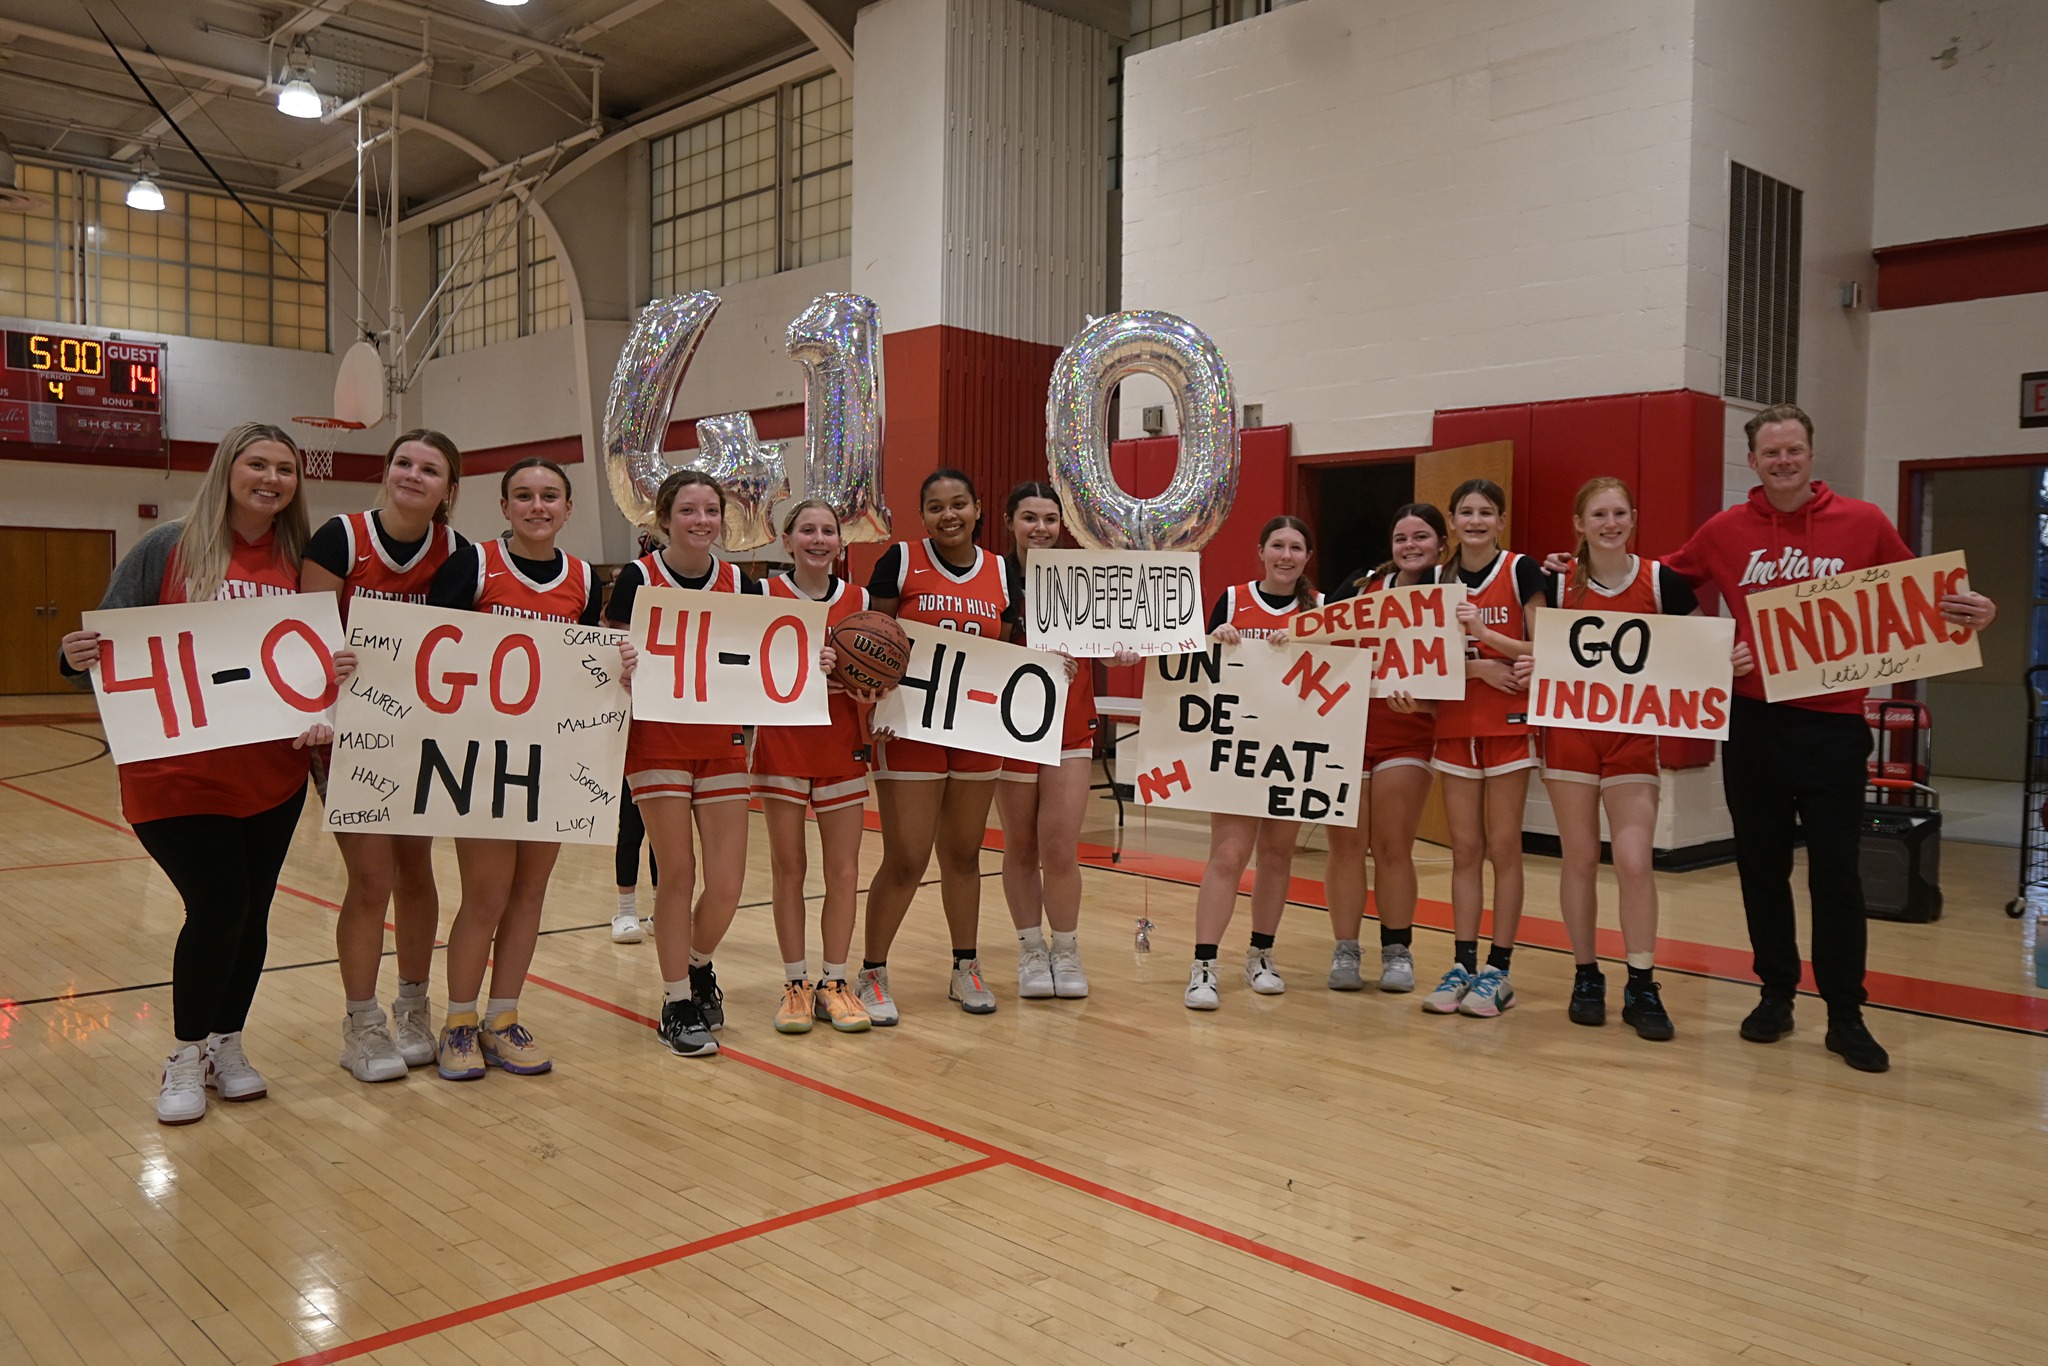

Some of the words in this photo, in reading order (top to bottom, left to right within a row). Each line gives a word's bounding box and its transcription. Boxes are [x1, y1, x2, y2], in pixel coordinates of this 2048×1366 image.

[29, 335, 101, 375] 5:00
[107, 345, 157, 363] GUEST
[40, 373, 72, 382] PERIOD
[48, 381, 64, 400] 4
[130, 364, 156, 395] 14
[102, 396, 134, 408] BONUS
[77, 418, 142, 431] SHEETZ
[1035, 563, 1196, 634] UNDEFEATED
[1795, 576, 1855, 598] Let's
[1861, 568, 1890, 584] Go
[918, 594, 963, 612] NORTH
[966, 598, 997, 620] HILLS
[1295, 587, 1446, 638] DREAM
[350, 627, 402, 661] EMMY
[646, 606, 810, 704] 41-0
[853, 633, 901, 672] Wilson
[1178, 637, 1198, 653] NH
[1569, 616, 1651, 675] GO
[97, 618, 340, 739] 41-0
[415, 624, 541, 716] GO
[844, 663, 883, 689] NCAA
[1281, 650, 1352, 717] NH
[1822, 662, 1869, 690] Let's
[349, 677, 412, 720] LAUREN
[897, 637, 1057, 744] 41-0
[1535, 679, 1728, 730] INDIANS
[557, 709, 627, 735] MALLORY
[1178, 693, 1259, 735] DE-
[338, 732, 395, 751] MADDI
[1210, 739, 1345, 783] FEAT-
[350, 766, 400, 803] HALEY
[412, 738, 542, 824] NH
[569, 762, 616, 806] JORDYN
[1137, 759, 1192, 805] NH
[328, 806, 391, 826] GEORGIA
[1268, 782, 1349, 820] ED!
[556, 815, 595, 839] LUCY
